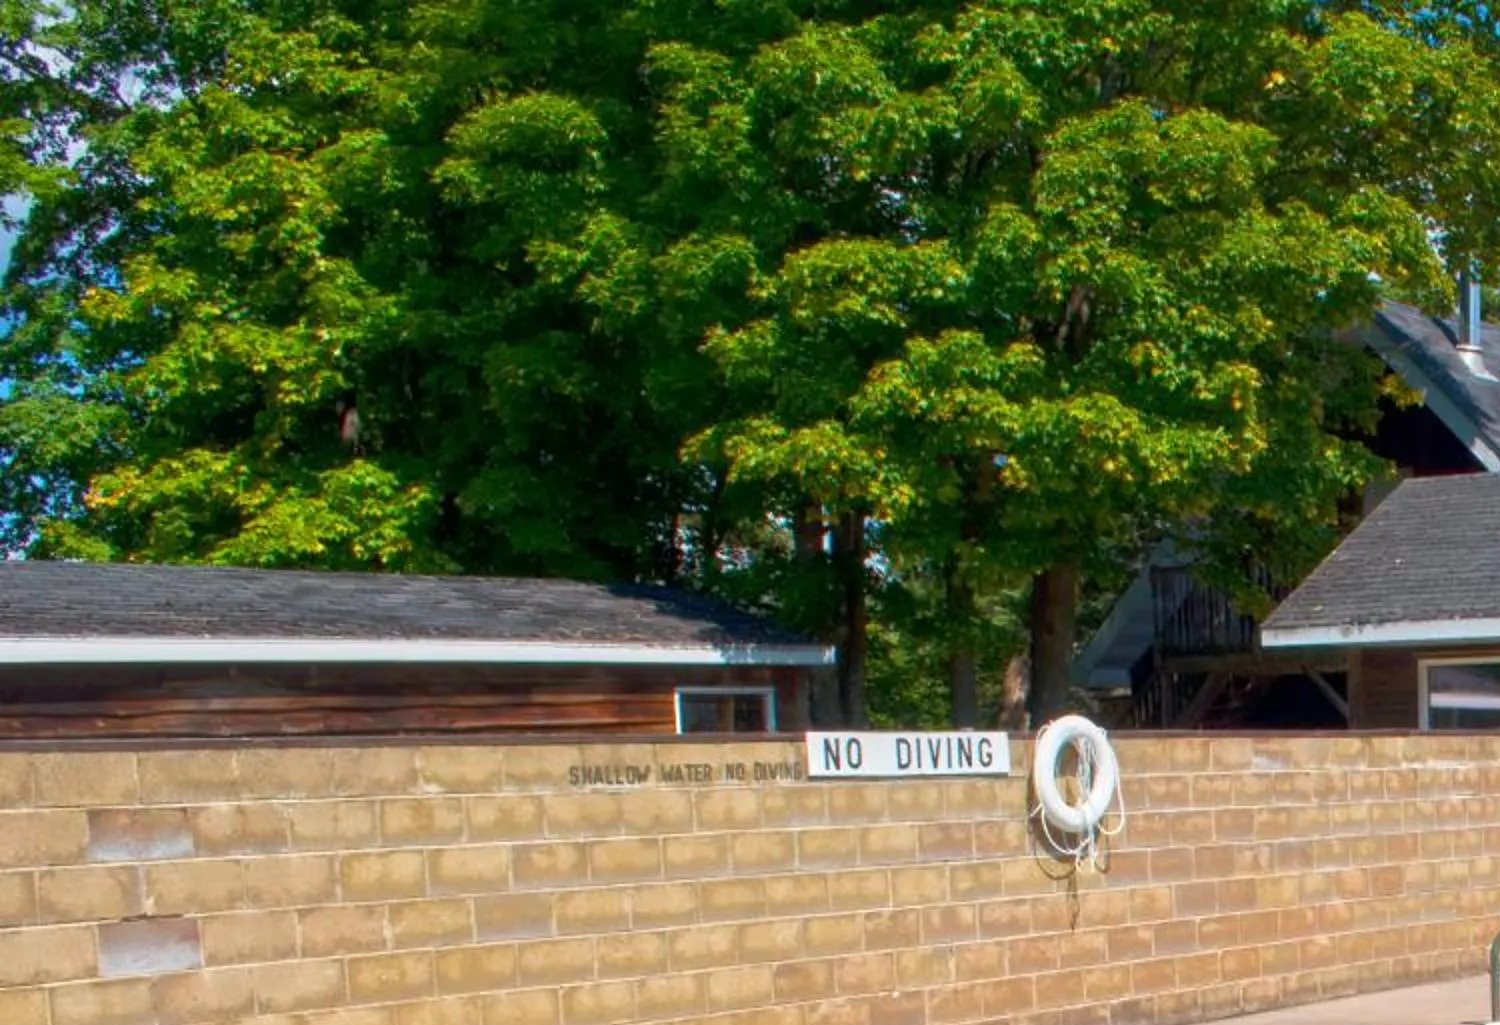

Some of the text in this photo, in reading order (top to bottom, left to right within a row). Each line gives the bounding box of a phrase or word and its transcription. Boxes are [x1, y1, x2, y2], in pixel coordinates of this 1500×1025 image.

[823, 736, 993, 771] NO DIVING
[568, 761, 802, 785] SHALLOW WATER NO DIVING
